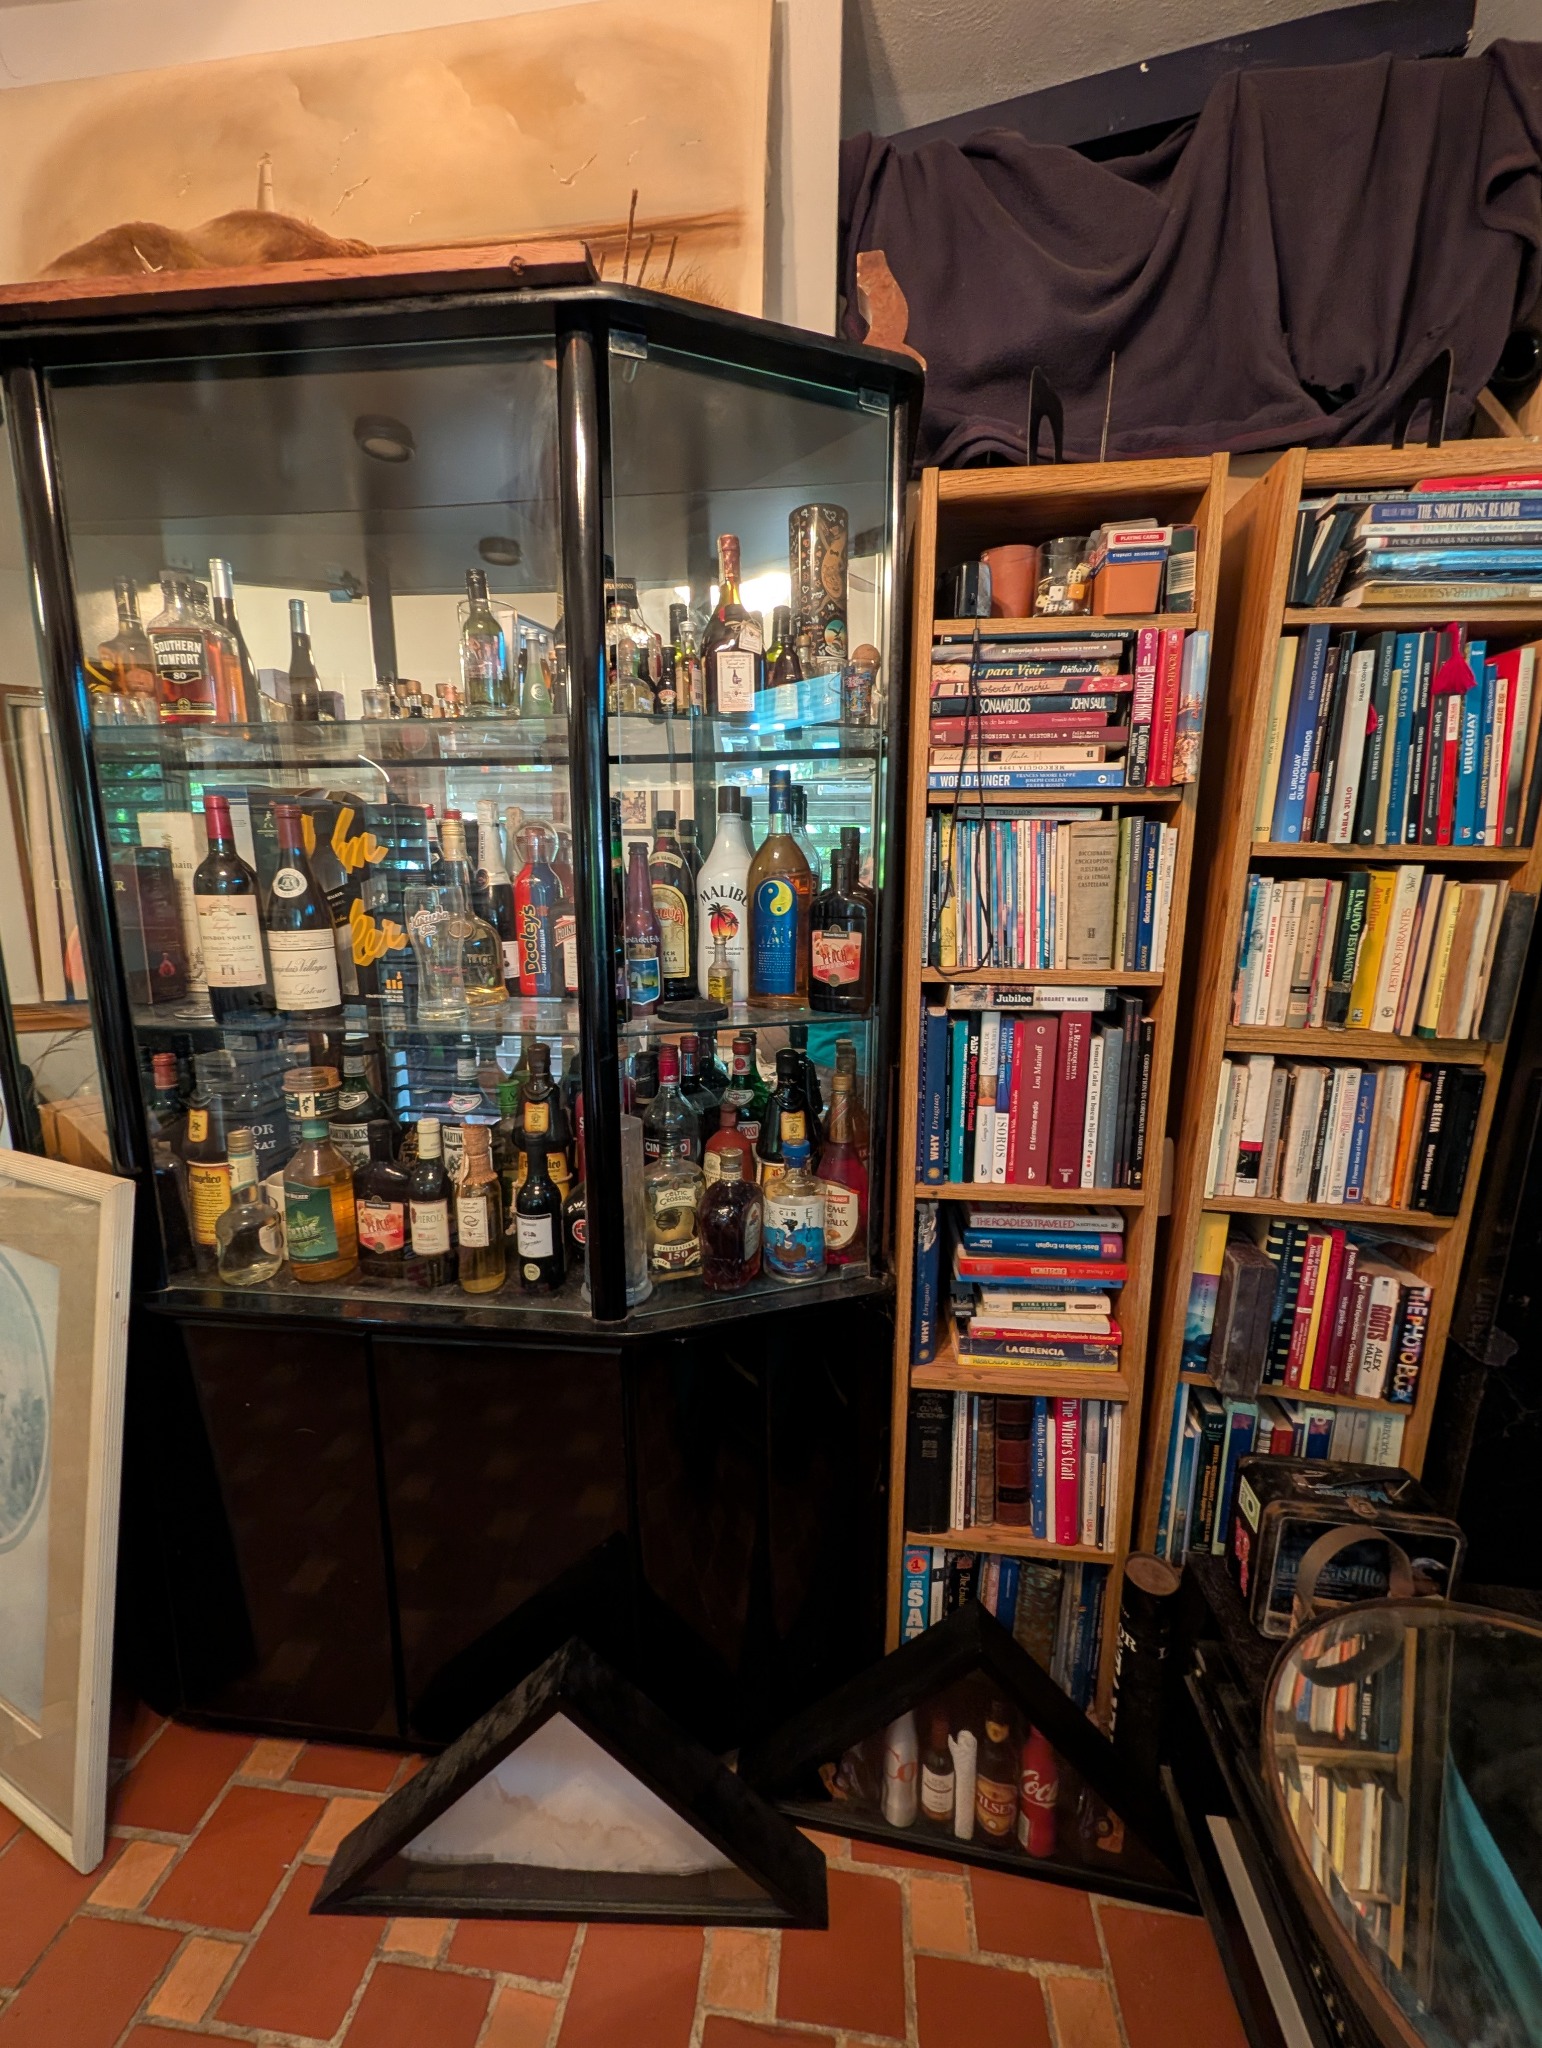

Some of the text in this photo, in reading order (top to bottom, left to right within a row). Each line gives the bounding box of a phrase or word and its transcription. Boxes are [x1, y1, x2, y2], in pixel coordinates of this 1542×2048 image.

[1418, 502, 1520, 519] THE SHORT PROSE READER
[154, 640, 201, 654] SOUTHERN
[1312, 638, 1323, 669] PASCALE
[158, 654, 200, 666] COMFORT
[986, 664, 1044, 678] para Vivir
[1060, 664, 1096, 674] Richard
[1382, 645, 1392, 686] DIEGO FISCHER
[173, 672, 186, 680] 80
[1308, 670, 1319, 700] RICARDO
[1358, 661, 1368, 701] PABLO COHEN
[1398, 642, 1413, 717] DIEGO FISCHER
[1070, 697, 1090, 710] JOHN
[1090, 695, 1106, 708] SAUL
[1133, 674, 1154, 721] STEPHEN KING
[1518, 694, 1528, 726] FISCHER
[1136, 725, 1150, 763] THE GUNSLINGER
[1463, 712, 1476, 774] URUGUAY
[1289, 754, 1301, 800] EL URUGUAY
[1297, 730, 1313, 800] QUE NOS DEBEMOS
[941, 774, 1010, 786] WORLD HUNGER
[1340, 786, 1353, 838] HABLA JULIO
[700, 885, 747, 907] MALIBU
[1356, 889, 1366, 898] EL
[1143, 893, 1152, 923] diccionario
[1255, 896, 1265, 927] DIANA
[1350, 900, 1364, 931] NUEVO
[520, 904, 541, 975] Dooley's
[1387, 908, 1411, 993] DESTINOS ERRANTES
[822, 950, 847, 964] PEACH
[996, 992, 1032, 1004] Jubilee
[968, 1036, 978, 1055] PADI
[1070, 1035, 1080, 1080] RECONQUISTA
[1093, 1044, 1101, 1068] Ismael
[968, 1056, 977, 1073] Open
[1034, 1045, 1043, 1074] Marinoff
[968, 1074, 976, 1090] Water
[1033, 1076, 1042, 1089] Lou
[1141, 1054, 1150, 1091] CORRUPTION
[930, 1093, 940, 1160] WHY Uruguay
[967, 1109, 975, 1131] Manual
[1137, 1100, 1147, 1133] CORPORATE
[1429, 1103, 1443, 1133] SELENA
[445, 1128, 463, 1143] MARTIN
[997, 1122, 1007, 1158] SOROS
[1029, 1121, 1038, 1143] término
[1087, 1123, 1096, 1137] hijo
[646, 1142, 687, 1153] CINO
[1088, 1139, 1094, 1148] de
[1136, 1135, 1144, 1160] AMERICA
[660, 1195, 692, 1206] CROSSING
[367, 1219, 389, 1233] PEACH
[976, 1217, 1075, 1229] THE ROAD LESS TRAVELED
[668, 1250, 688, 1260] 150
[1065, 1243, 1081, 1251] Skills
[921, 1319, 930, 1344] WHY
[1367, 1304, 1393, 1341] ROOTS
[1006, 1345, 1064, 1356] LA GERENCIA
[1347, 1344, 1357, 1362] Charles
[1363, 1343, 1374, 1373] HALEY
[1372, 1347, 1383, 1371] ALEX
[1036, 1414, 1045, 1477] Teddy Bear Tales
[1061, 1401, 1077, 1480] The Writer's Craft
